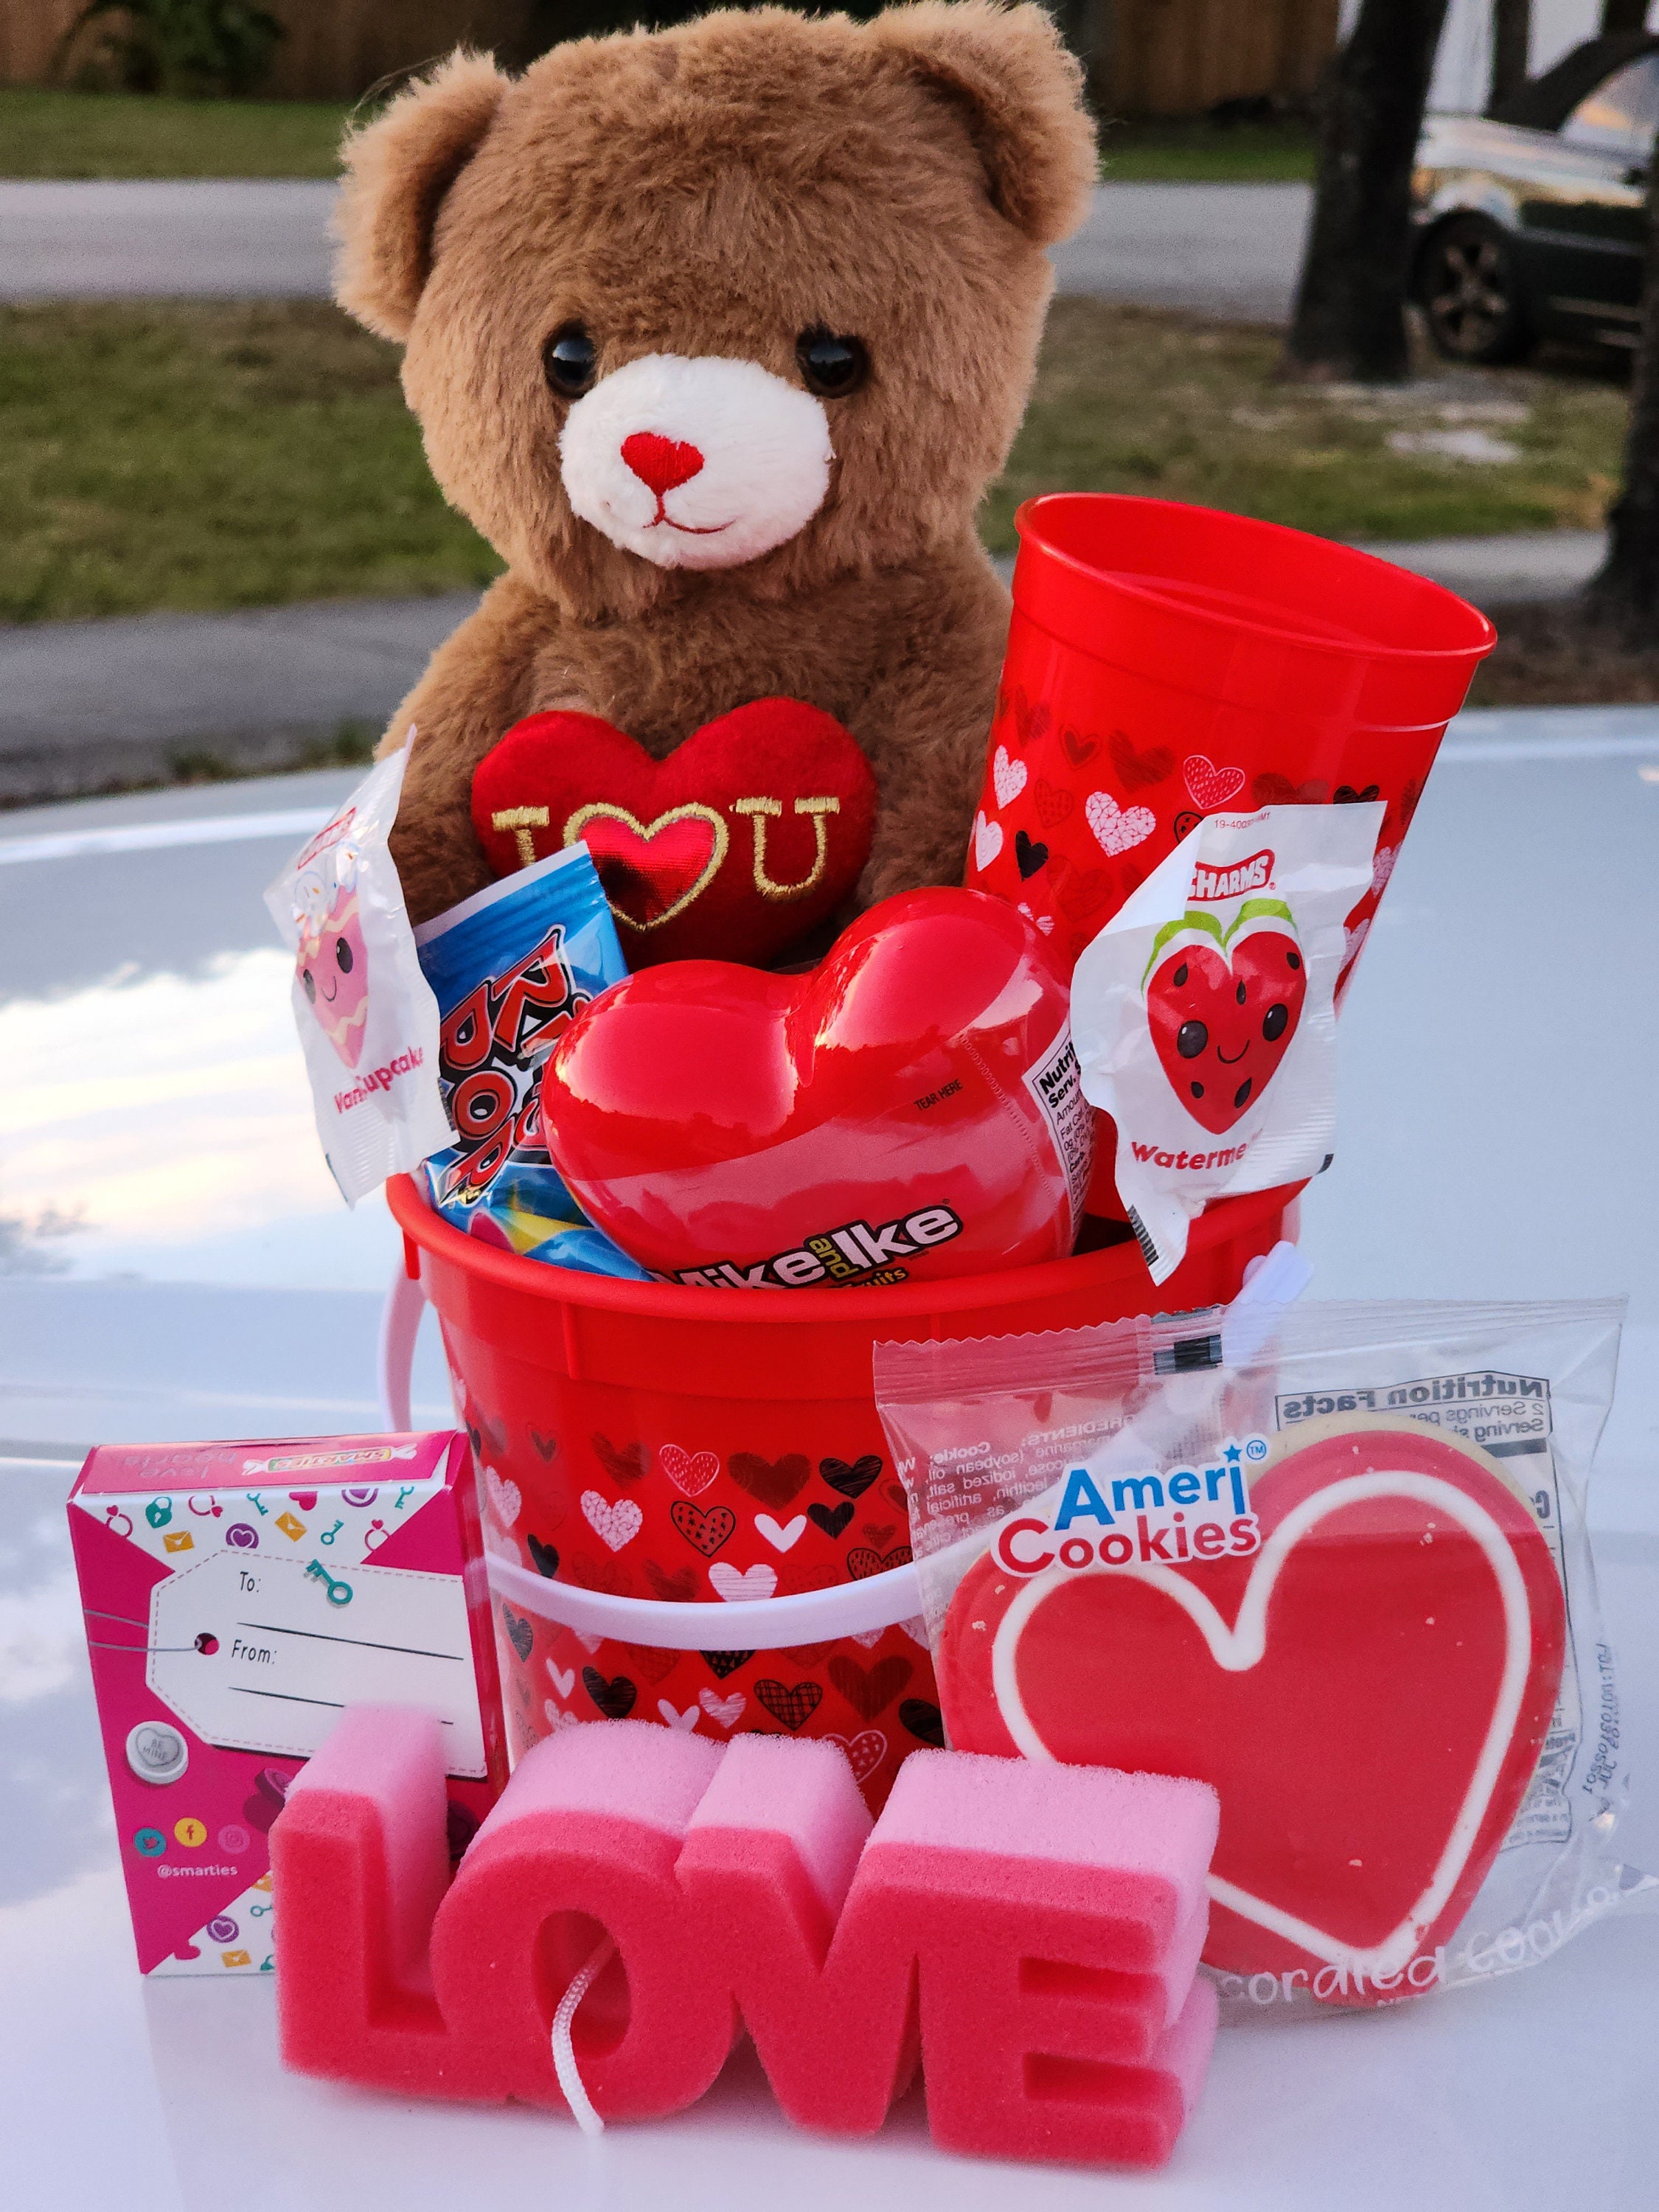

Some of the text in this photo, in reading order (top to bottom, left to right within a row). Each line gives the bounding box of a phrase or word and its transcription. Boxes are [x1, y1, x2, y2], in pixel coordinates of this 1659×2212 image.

[729, 796, 841, 900] U
[914, 1079, 963, 1110] TEAR HERE
[810, 1237, 860, 1279] and
[831, 1208, 959, 1269] Ike
[998, 1512, 1257, 1573] Cookies
[240, 1571, 261, 1593] To:
[231, 1638, 277, 1665] From:
[156, 1864, 239, 1879] @smarties
[268, 1711, 1220, 2170] LOVE
